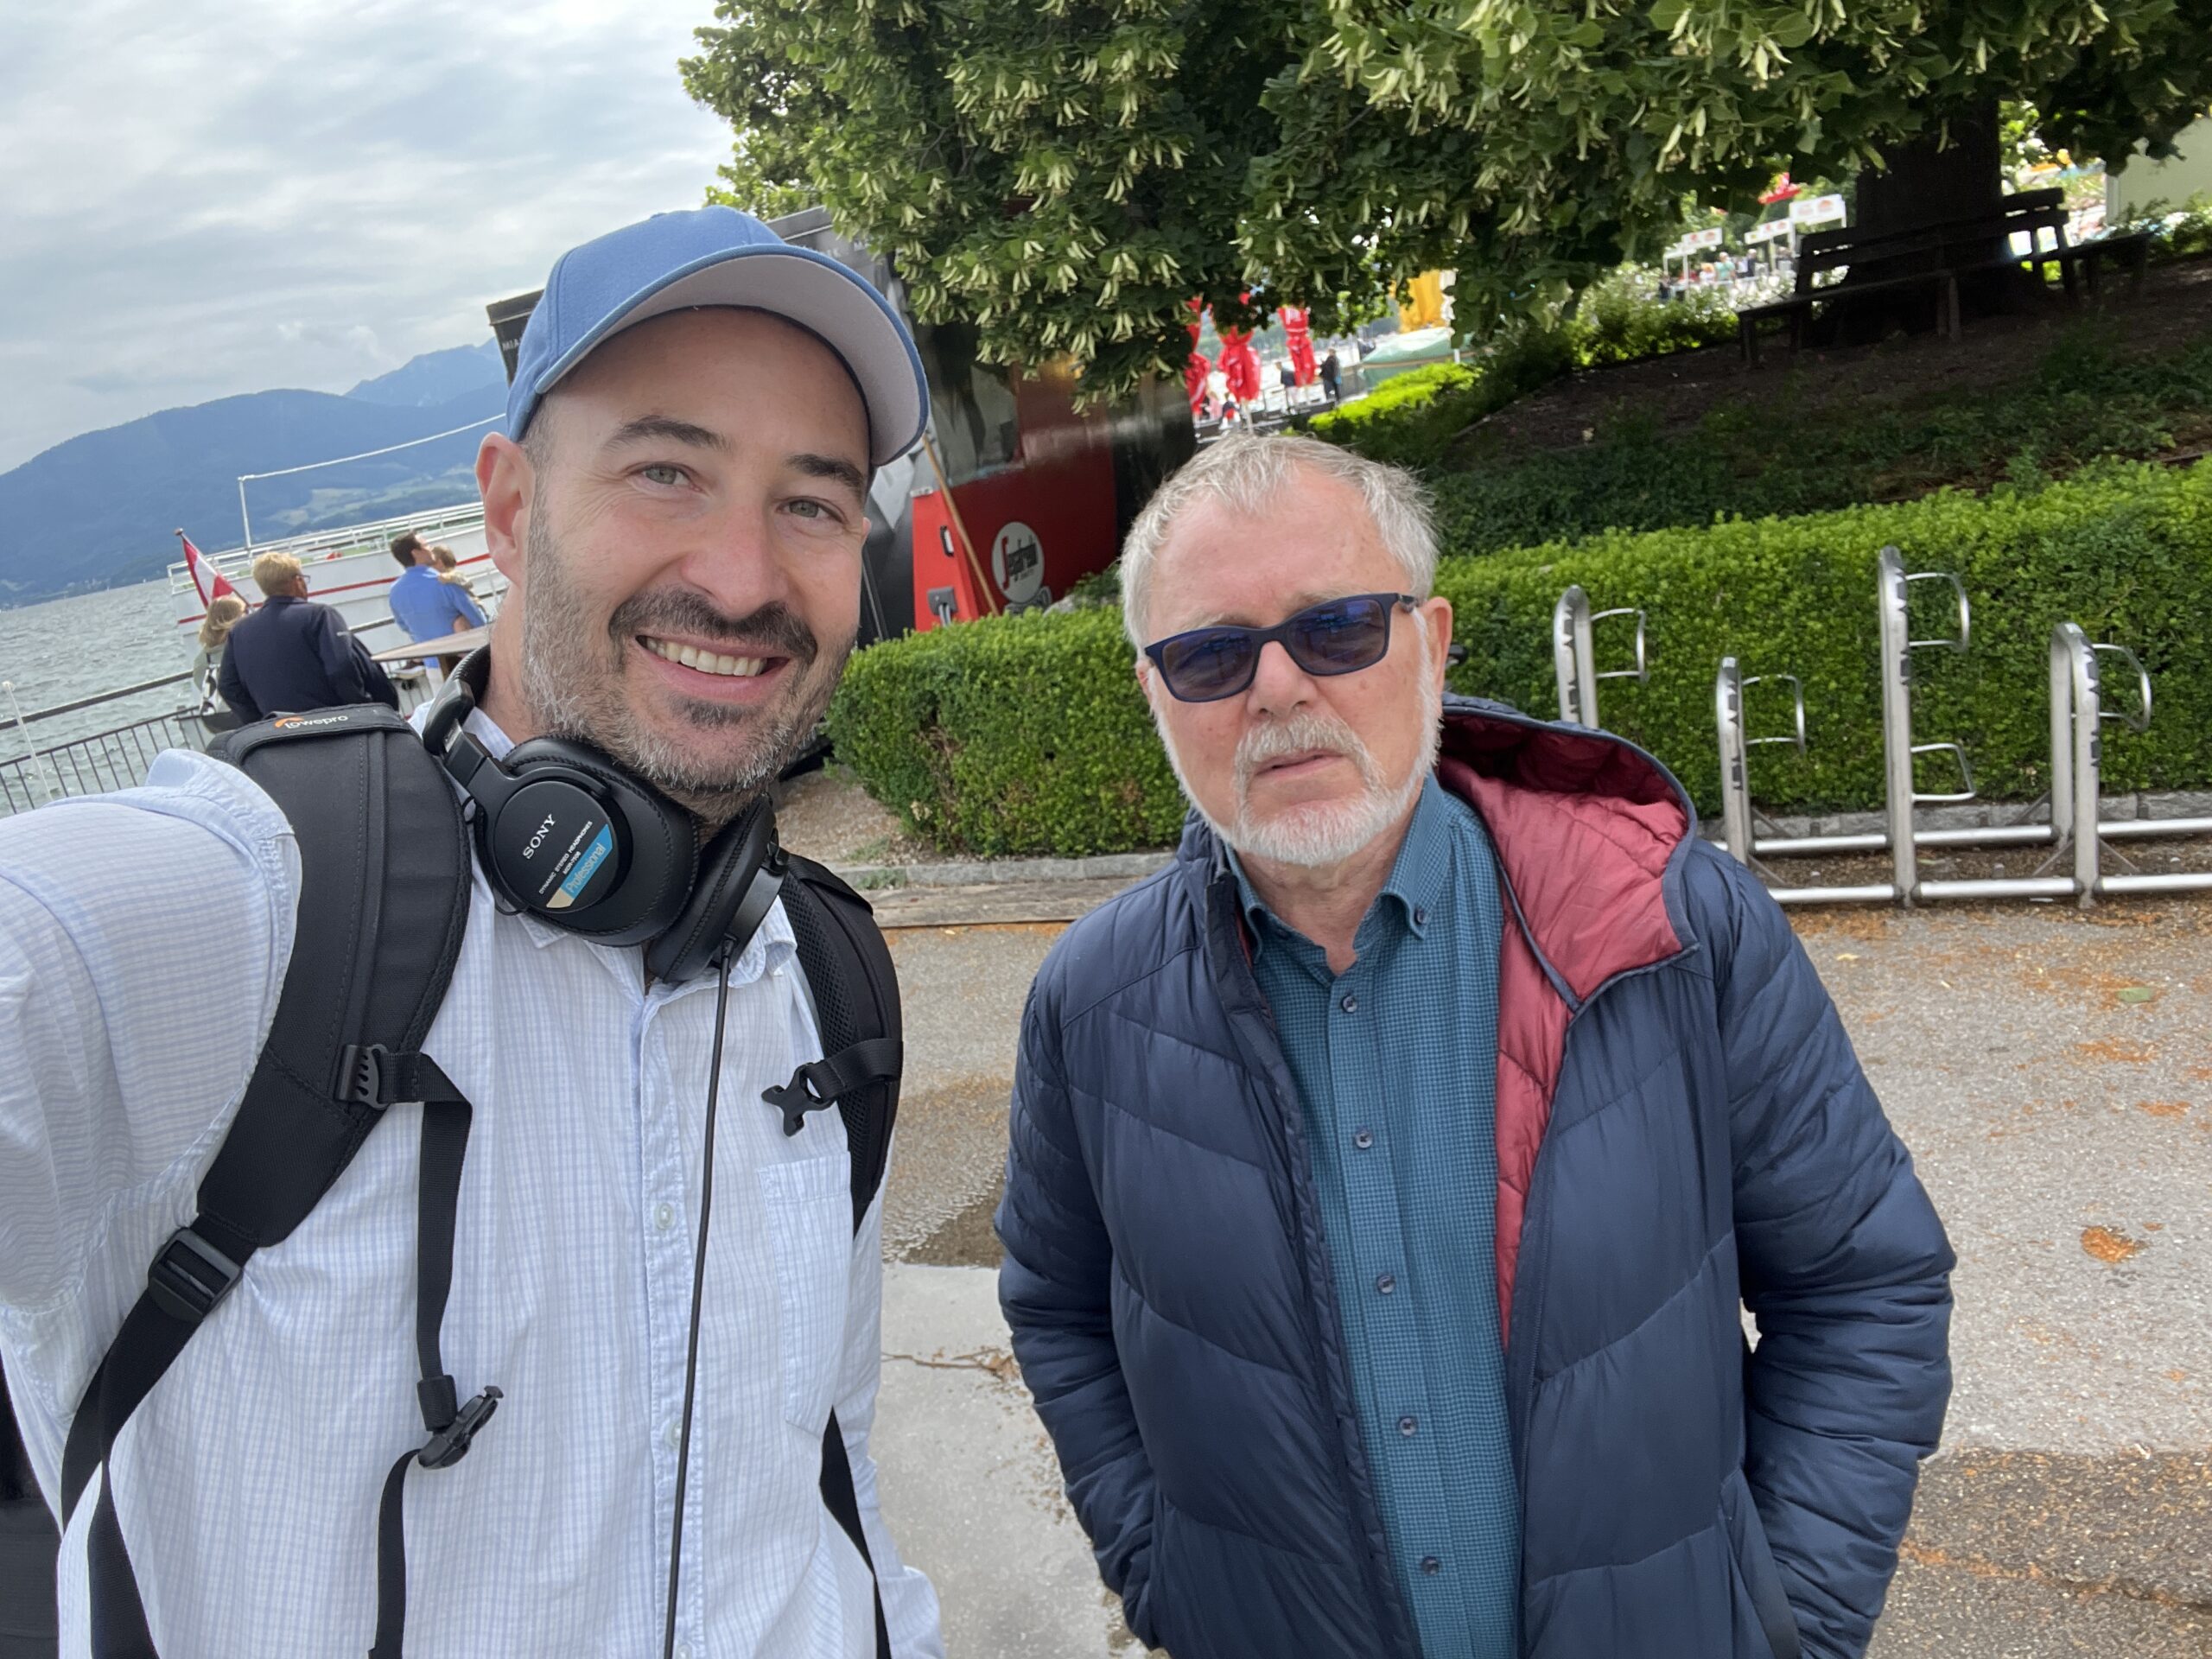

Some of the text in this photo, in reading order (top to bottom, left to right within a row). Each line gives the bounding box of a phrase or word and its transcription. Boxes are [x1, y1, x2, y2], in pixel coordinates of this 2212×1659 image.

[522, 814, 556, 860] SONY
[538, 820, 594, 895] DYNAMIC STEREO HEADPHONES
[565, 842, 607, 893] Professional
